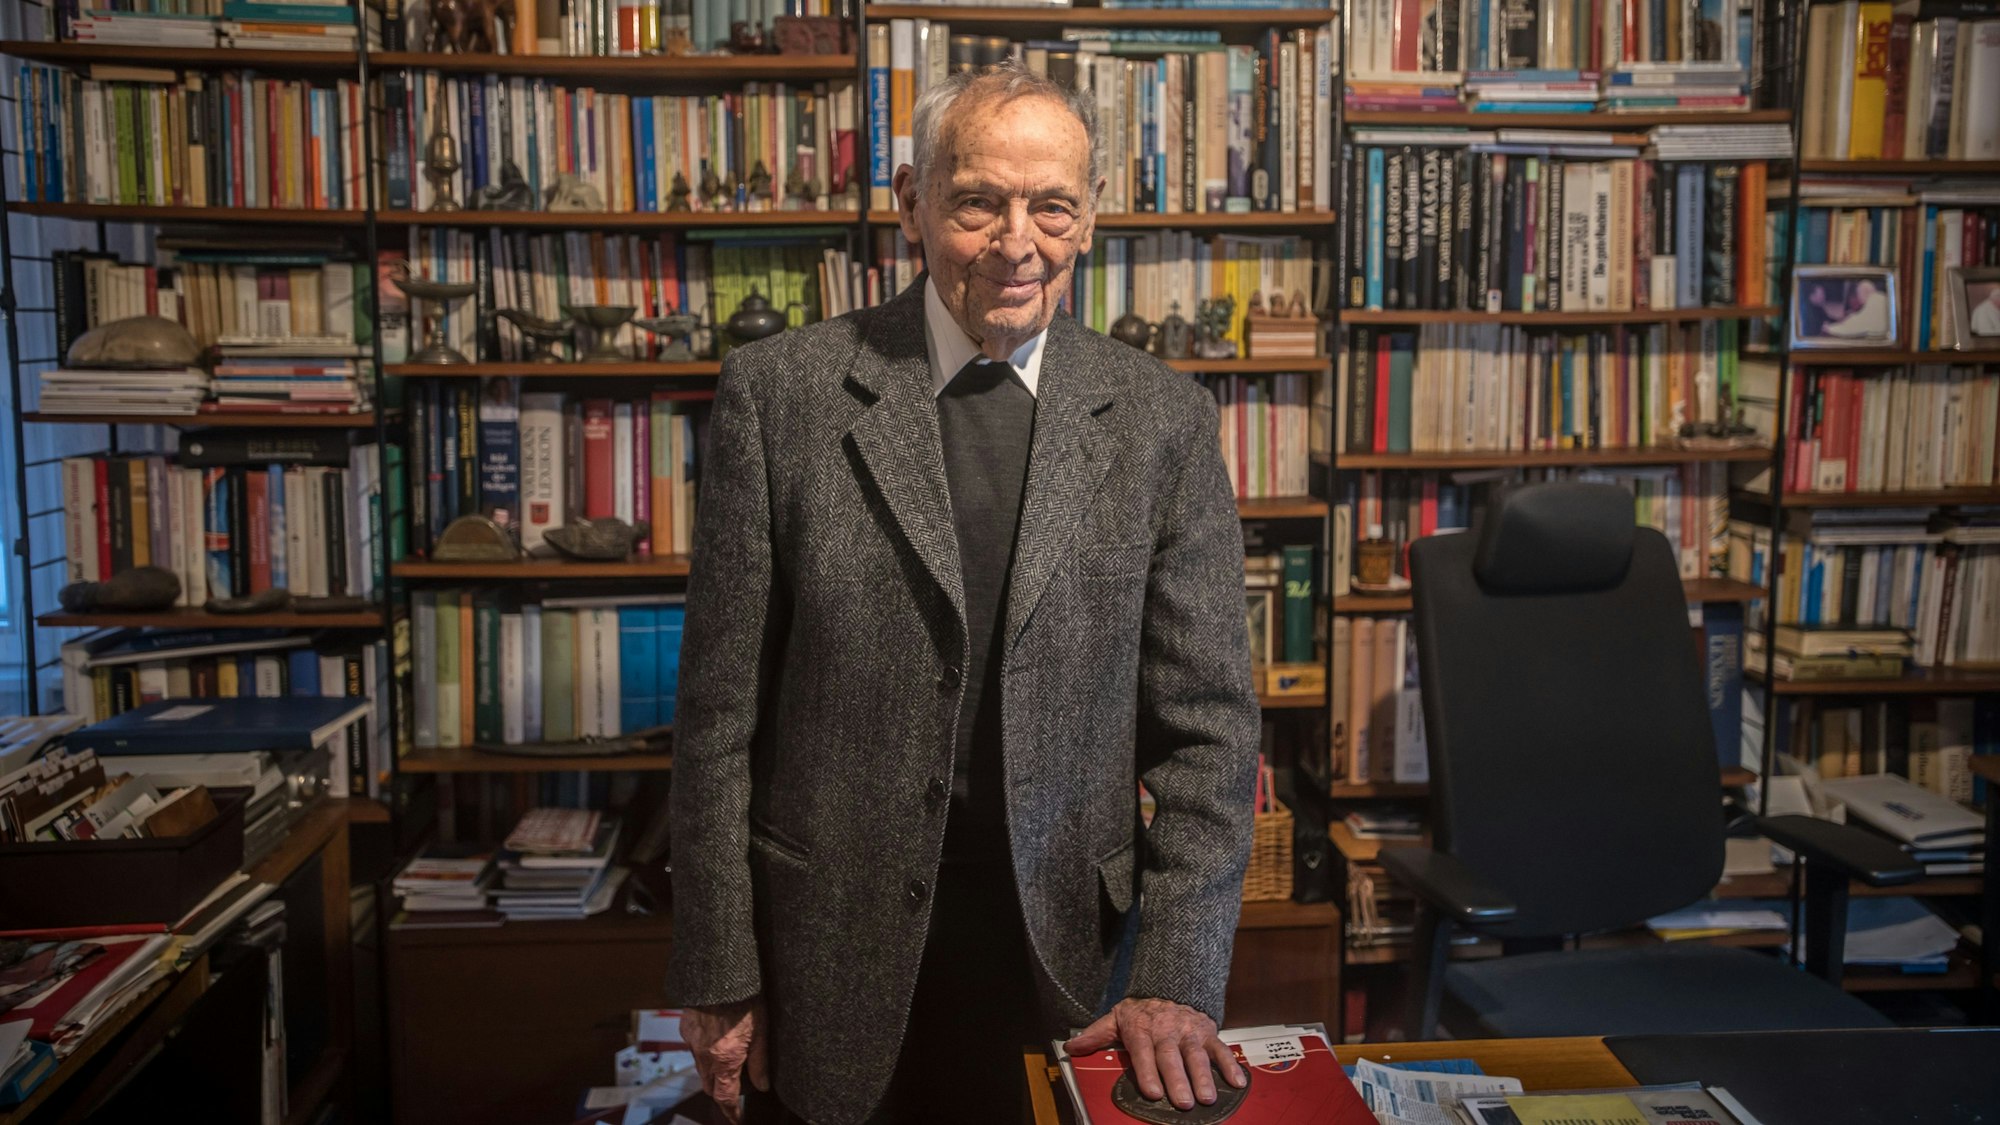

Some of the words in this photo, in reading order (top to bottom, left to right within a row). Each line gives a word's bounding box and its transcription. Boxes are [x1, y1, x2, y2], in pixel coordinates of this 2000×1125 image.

[1421, 150, 1439, 236] MASADA
[523, 427, 535, 498] VATIKAN
[539, 427, 552, 498] LEXIKON
